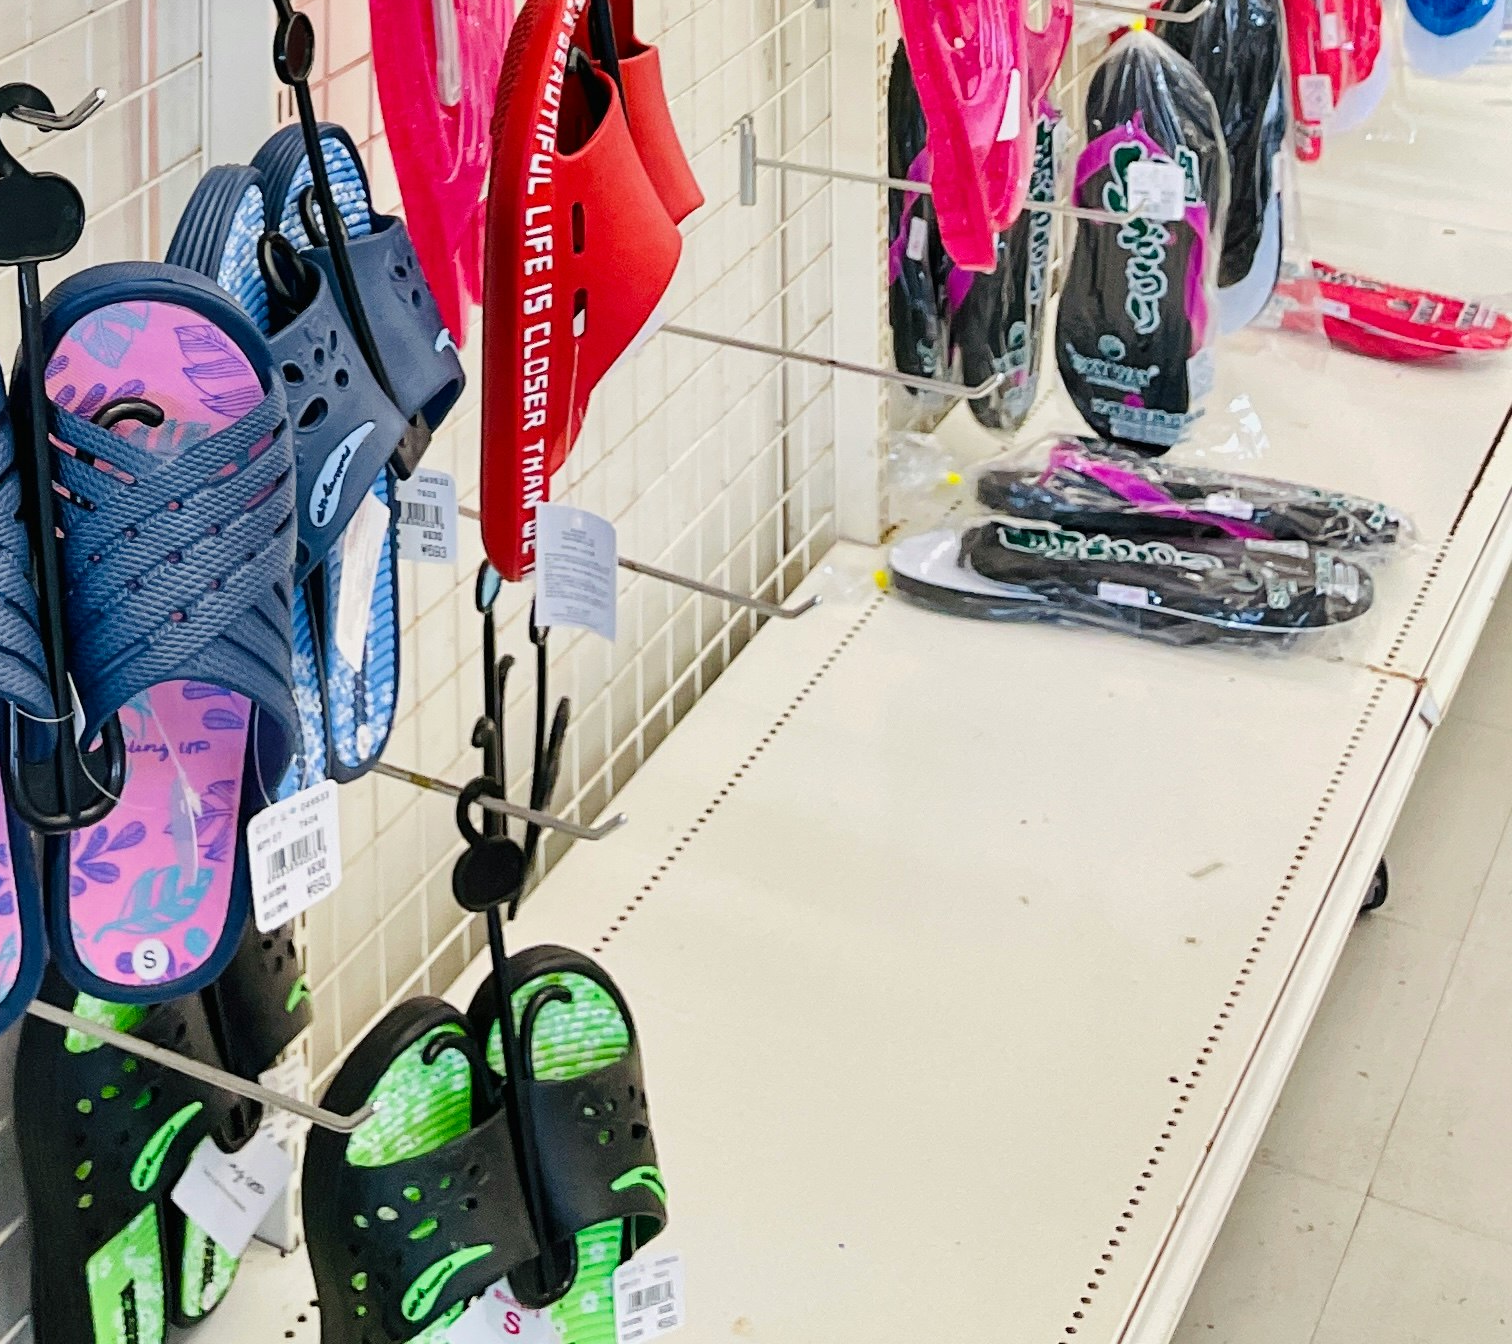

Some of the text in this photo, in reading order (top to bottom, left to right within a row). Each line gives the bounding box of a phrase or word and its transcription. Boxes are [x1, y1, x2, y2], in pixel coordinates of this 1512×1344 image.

[527, 31, 570, 195] BEAUTIFUL
[525, 204, 555, 276] LIFE
[523, 283, 553, 315] IS
[522, 322, 551, 432] CLOSER
[521, 439, 546, 510] THAN
[143, 950, 158, 969] S
[503, 1311, 521, 1335] S
